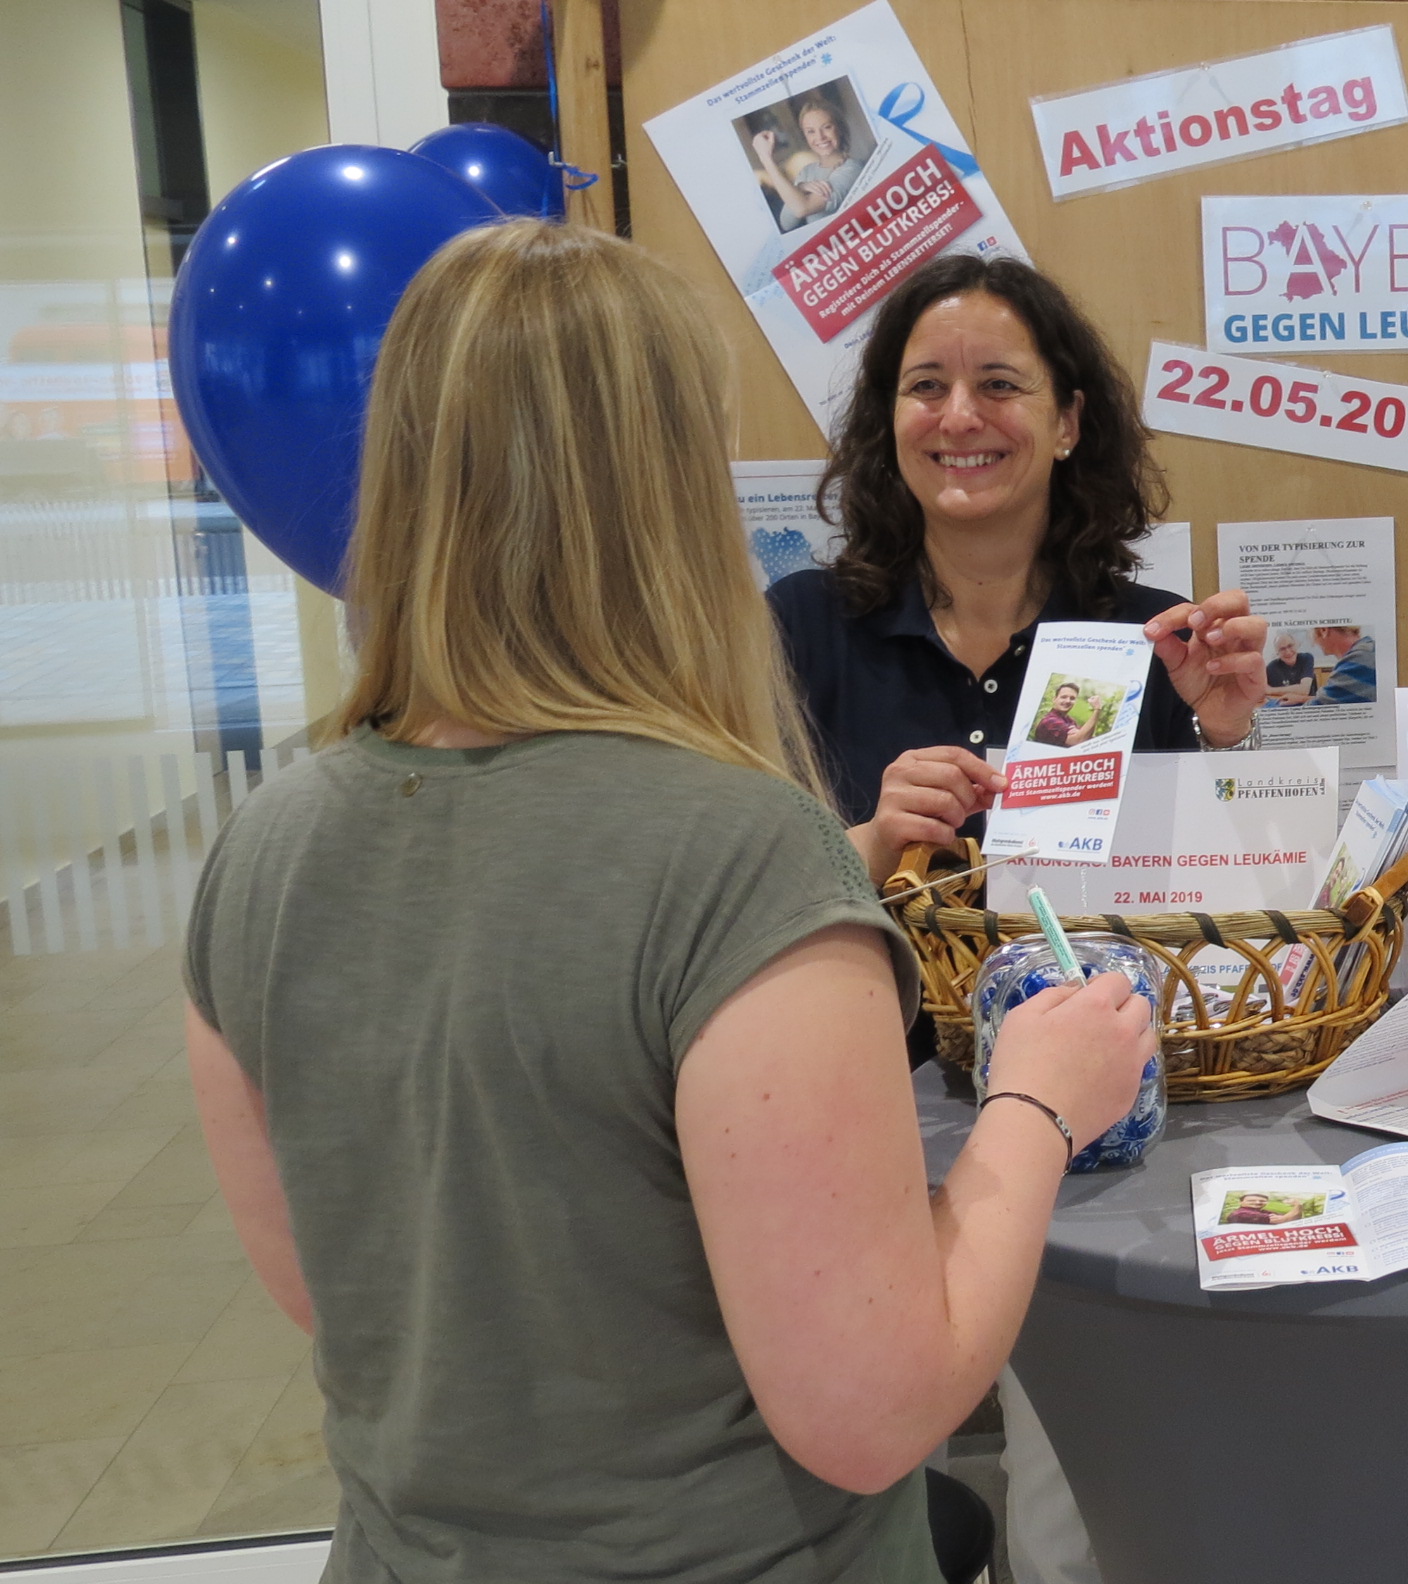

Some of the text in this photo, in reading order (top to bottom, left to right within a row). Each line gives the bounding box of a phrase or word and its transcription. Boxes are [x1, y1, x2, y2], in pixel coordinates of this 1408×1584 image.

[1059, 76, 1377, 177] Aktionstag
[782, 158, 943, 293] ÄRMEL HOCH
[800, 180, 955, 307] GEGEN BLUTKREBS!
[818, 202, 961, 319] Registriere Dich als Stammzellspender
[839, 222, 953, 316] mit Deinem LEBENSRETTERSET!
[1223, 311, 1346, 343] GEGEN
[748, 494, 765, 503] ein
[1239, 540, 1365, 553] VON DER TYPISIERUNG ZUR
[1239, 554, 1275, 563] SPENDE
[1012, 758, 1115, 780] ÄRMEL HOCH
[1010, 771, 1115, 790] GEGEN BLUTKREBS!
[1238, 787, 1318, 799] PFAFFENHOFEN
[1069, 837, 1103, 851] AKB
[1111, 855, 1172, 868] BAYERN
[1177, 854, 1229, 867] GEGEN
[1233, 849, 1307, 866] LEUKÄMIE
[1114, 891, 1203, 904] 22. MAI 2019
[1213, 1226, 1341, 1246] ÄRMEL HOCH
[1214, 1232, 1344, 1250] GEGEN BLUTKREBS!
[1316, 1265, 1359, 1275] AKB
